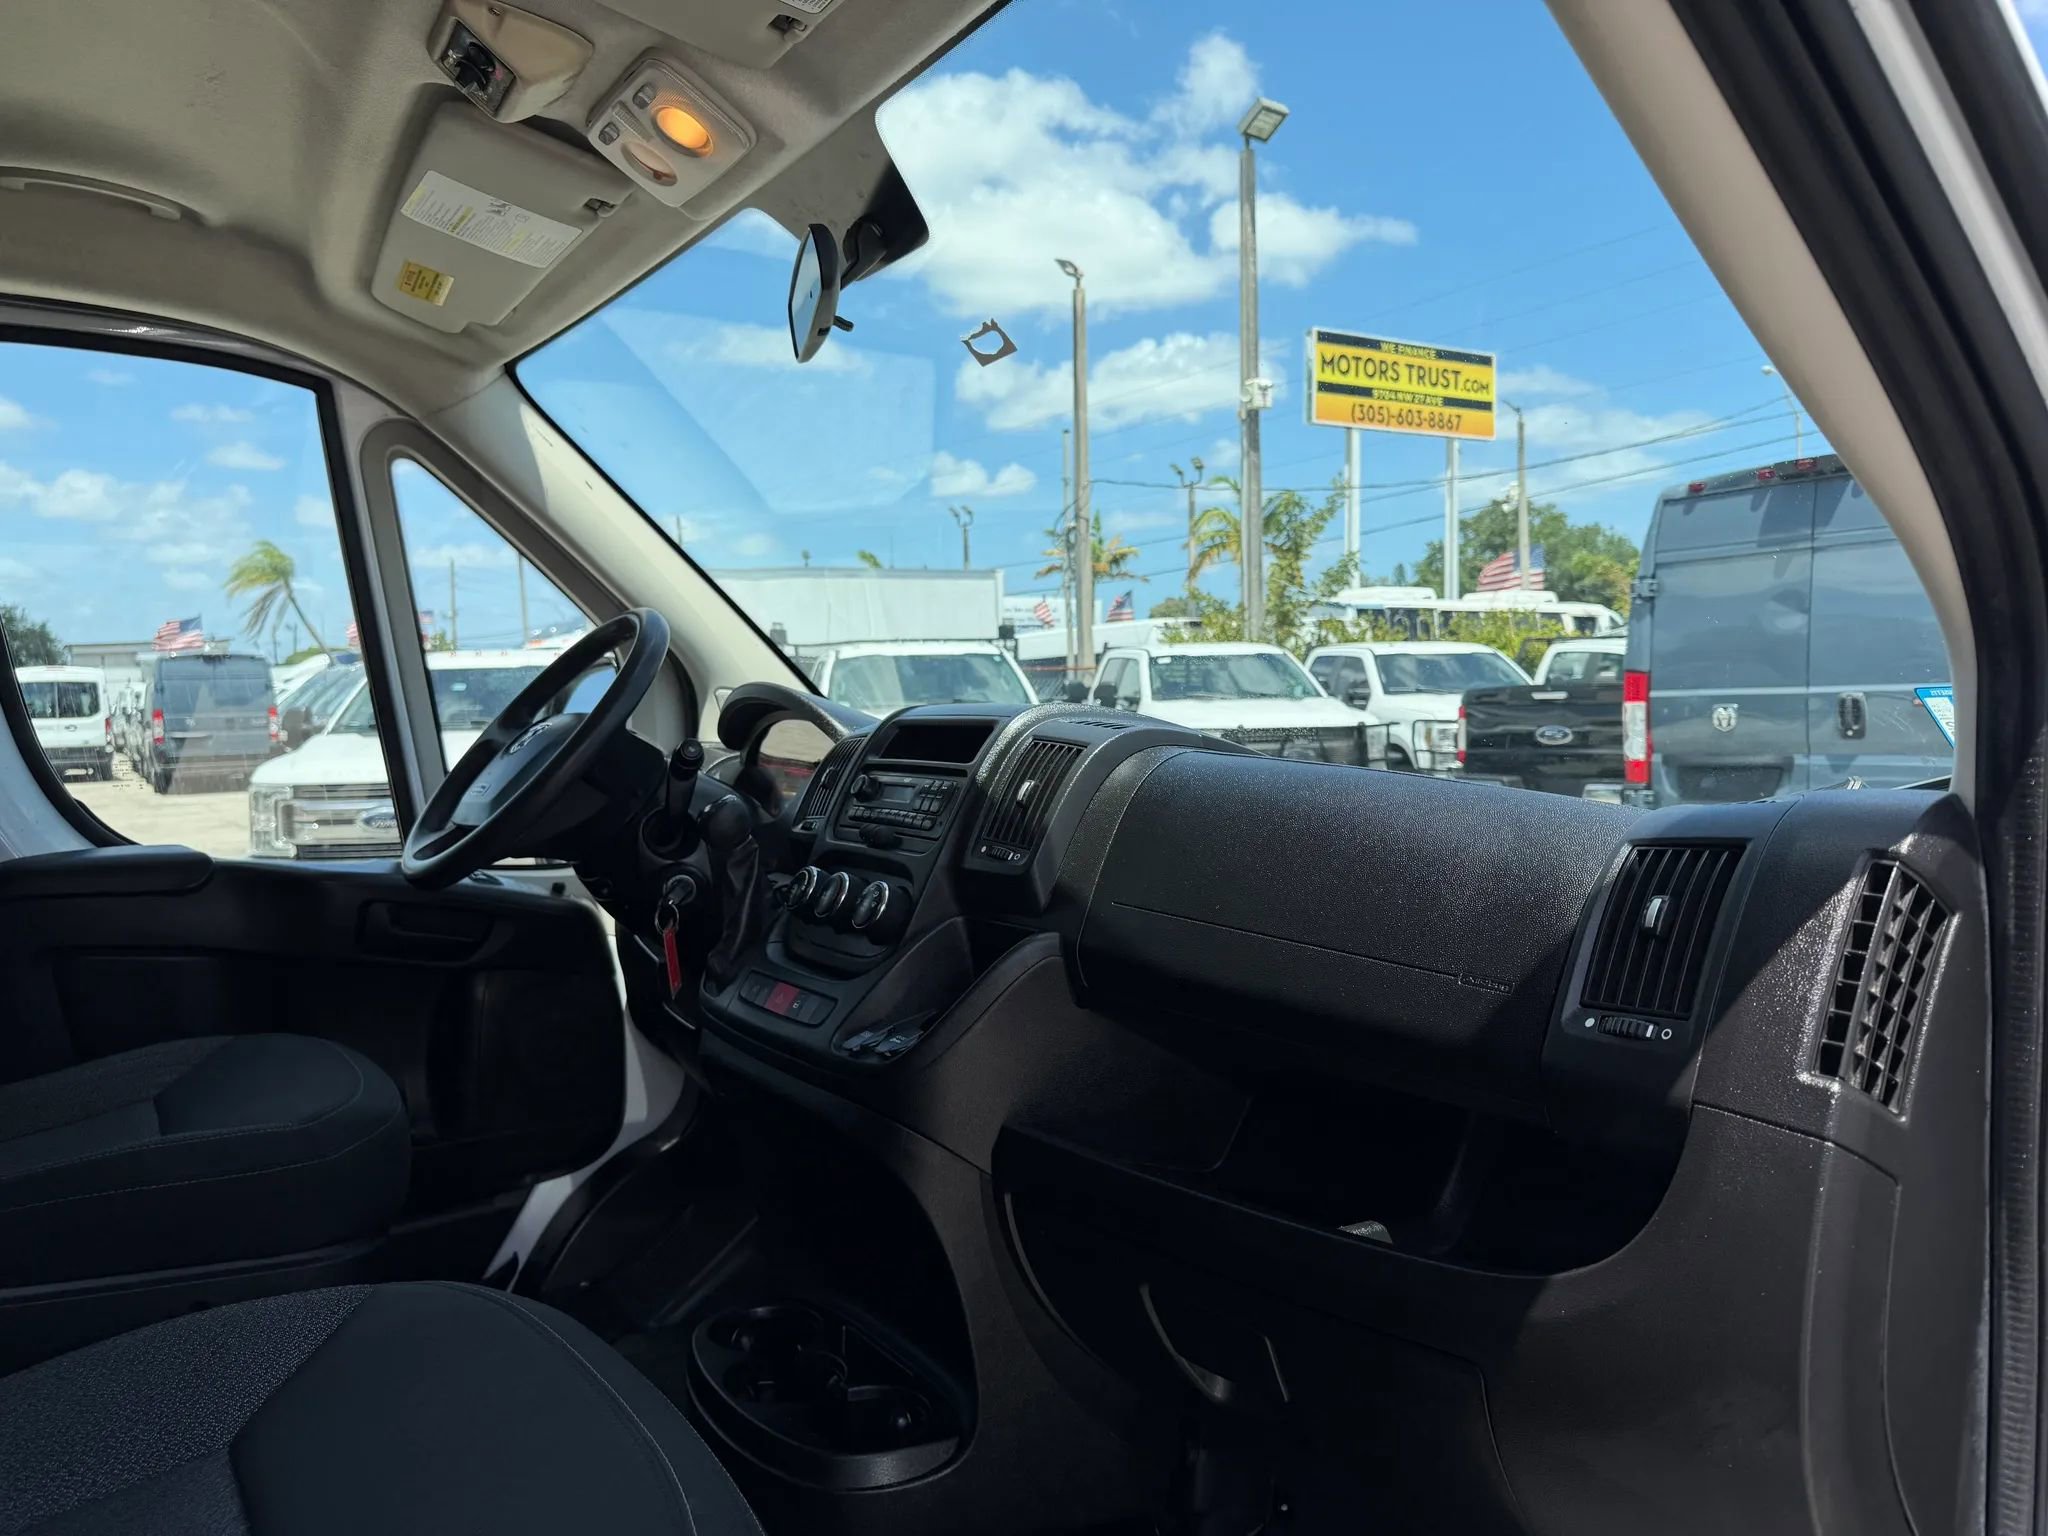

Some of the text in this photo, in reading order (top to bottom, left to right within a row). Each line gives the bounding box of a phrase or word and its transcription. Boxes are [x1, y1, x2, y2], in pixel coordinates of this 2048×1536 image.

[1380, 341, 1397, 354] WE
[1320, 352, 1490, 395] MOTORS TRUST.COM
[1351, 403, 1462, 431] (305)-603-8867
